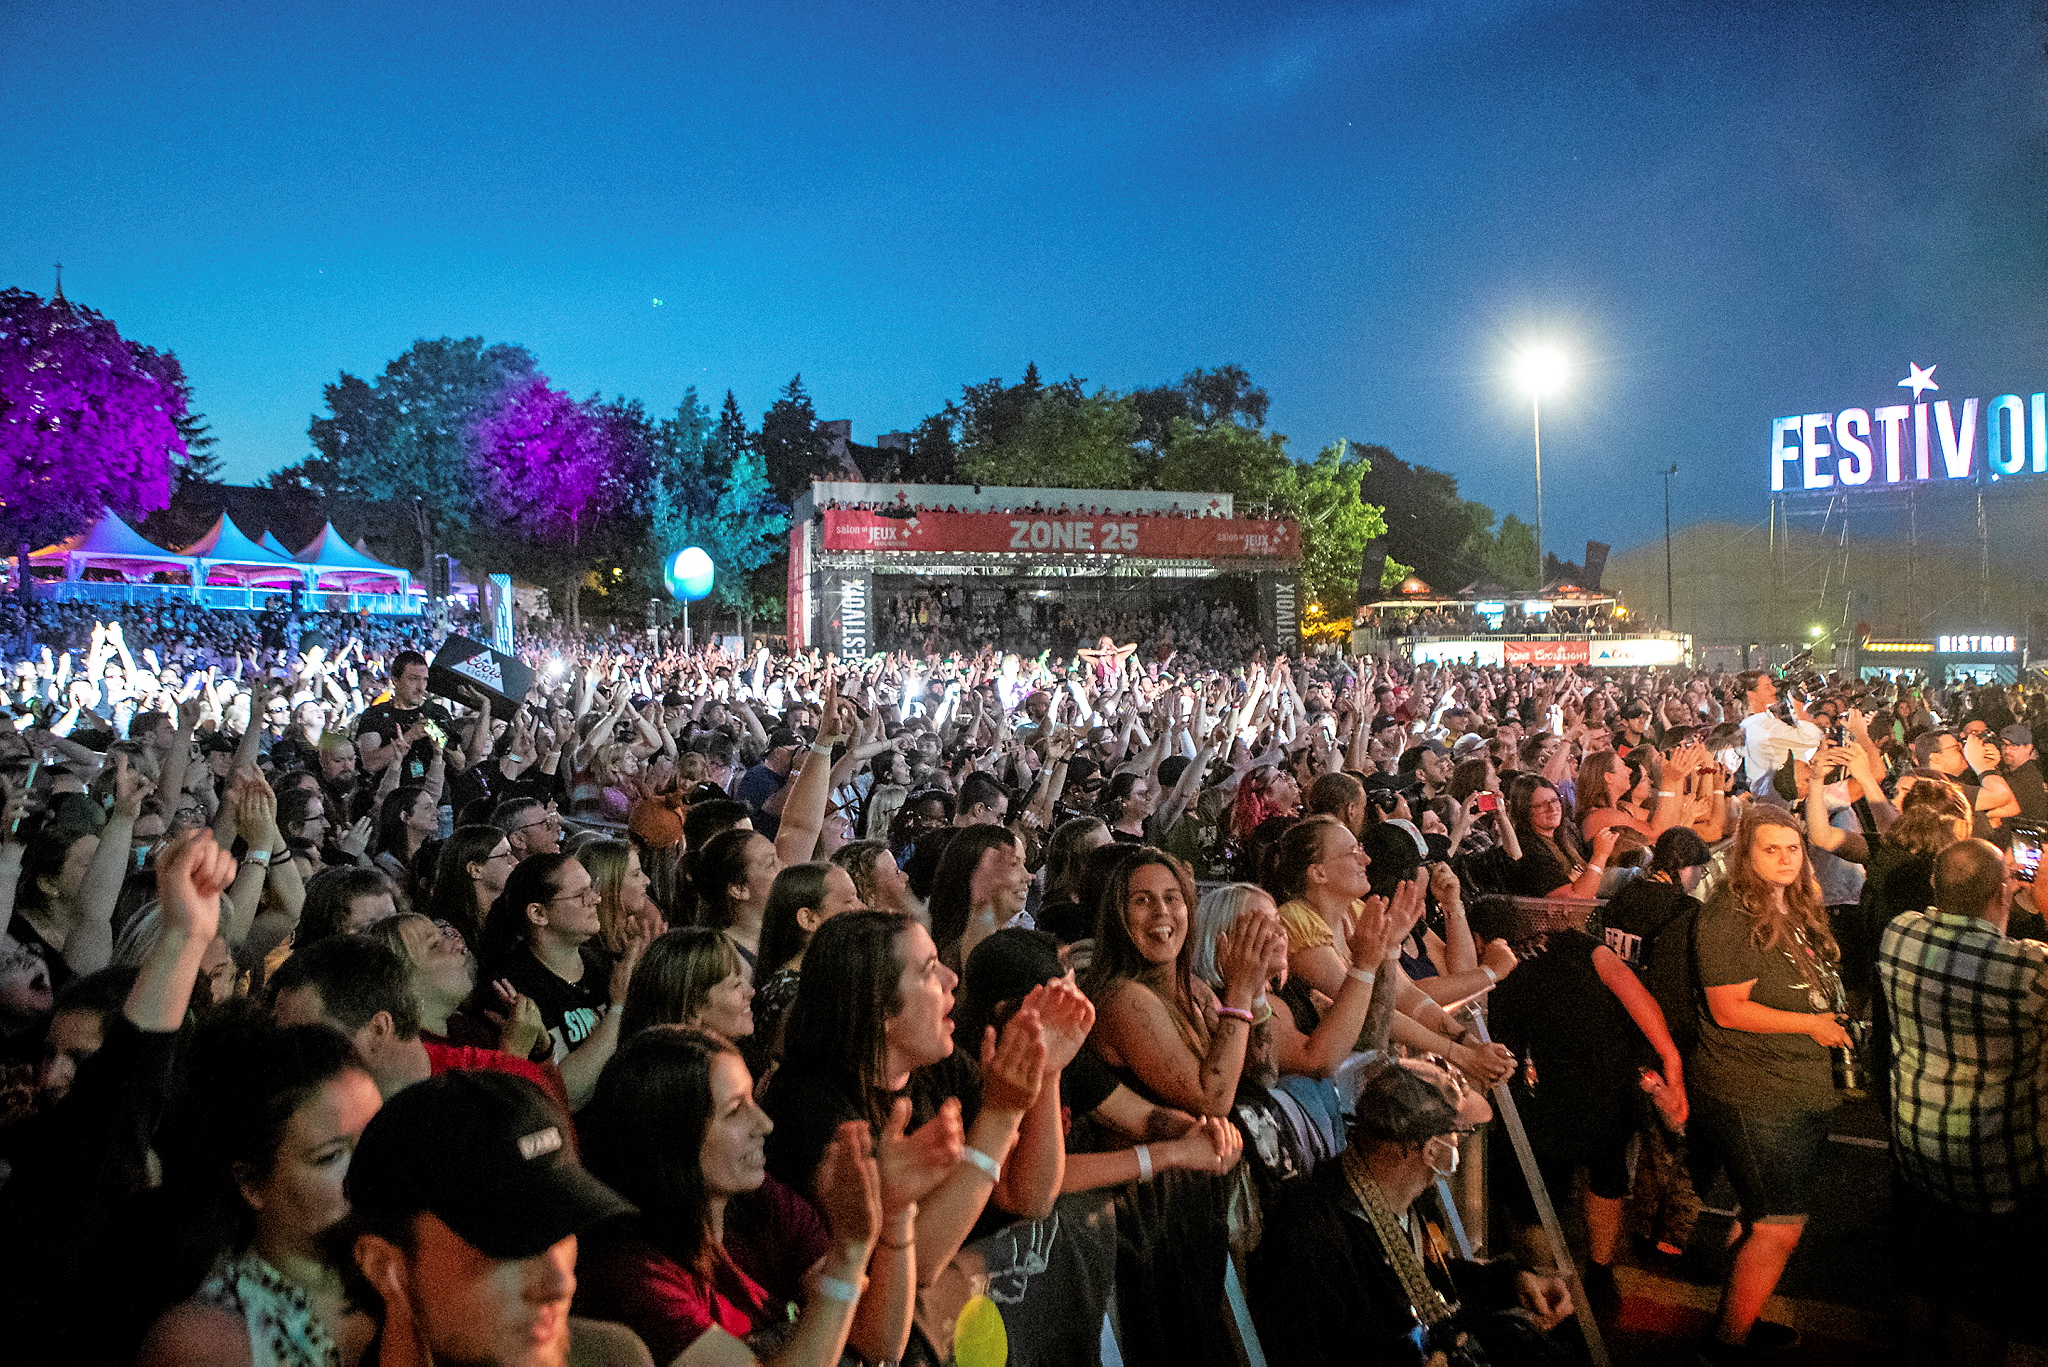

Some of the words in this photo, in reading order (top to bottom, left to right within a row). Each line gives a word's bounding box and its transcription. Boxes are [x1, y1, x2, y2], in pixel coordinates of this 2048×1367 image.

[836, 525, 860, 534] salon
[868, 526, 897, 543] JEUX
[1010, 521, 1094, 549] ZONE
[1101, 523, 1138, 550] 25
[842, 578, 867, 661] ESTIVOIX
[1276, 583, 1296, 652] STIVOIX
[1938, 635, 2016, 653] BISTROS
[466, 666, 495, 682] LIGHT
[467, 655, 501, 678] Coors
